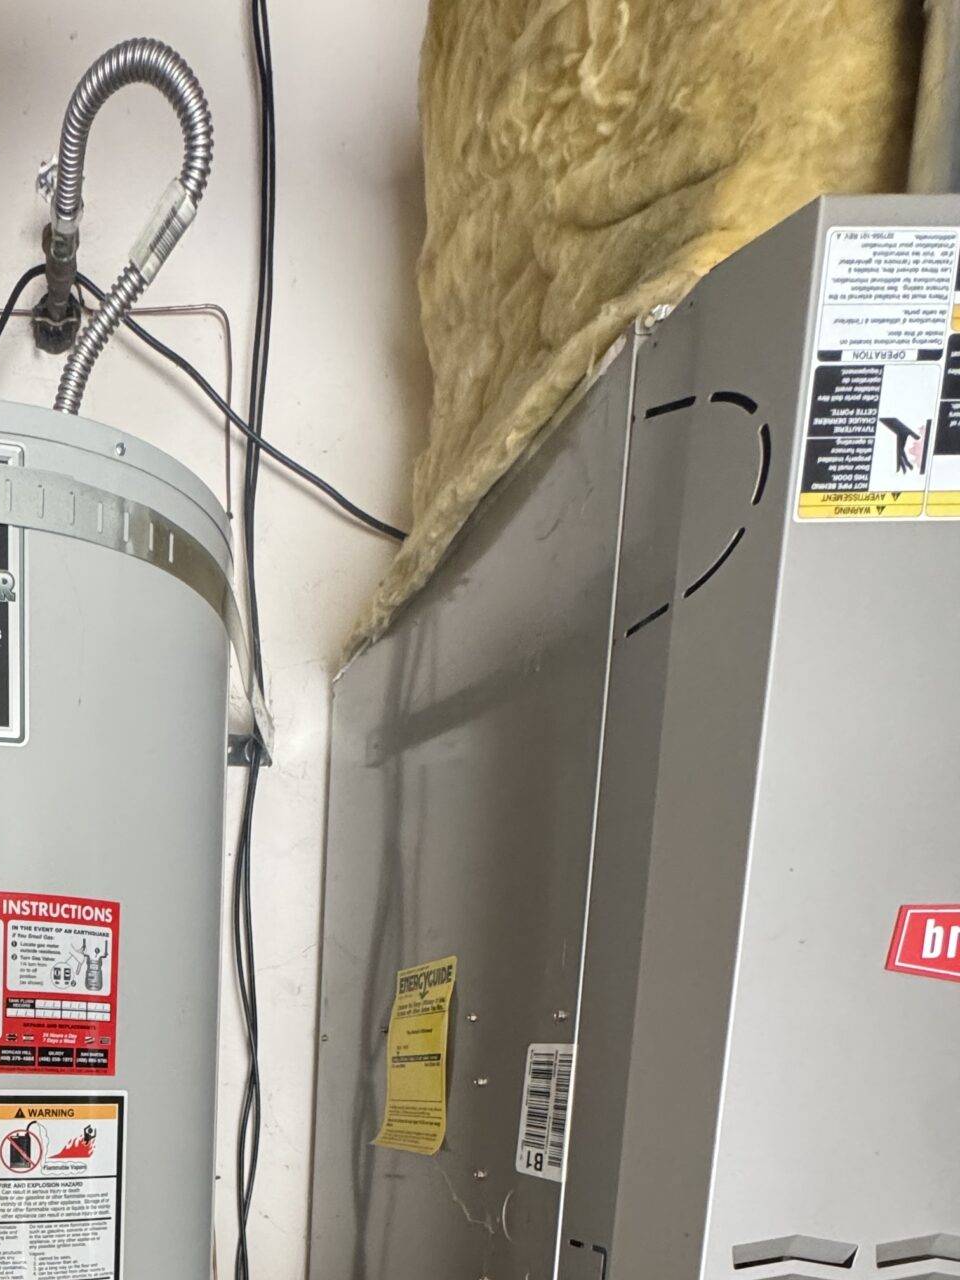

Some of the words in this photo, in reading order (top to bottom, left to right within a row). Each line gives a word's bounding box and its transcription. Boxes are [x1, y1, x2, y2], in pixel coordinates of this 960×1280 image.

[853, 351, 905, 360] OPERATION
[822, 494, 886, 502] AVERTISSEMENT
[2, 900, 113, 922] INSTRUCTIONS
[28, 1108, 75, 1117] WARNING
[526, 1151, 543, 1171] B1
